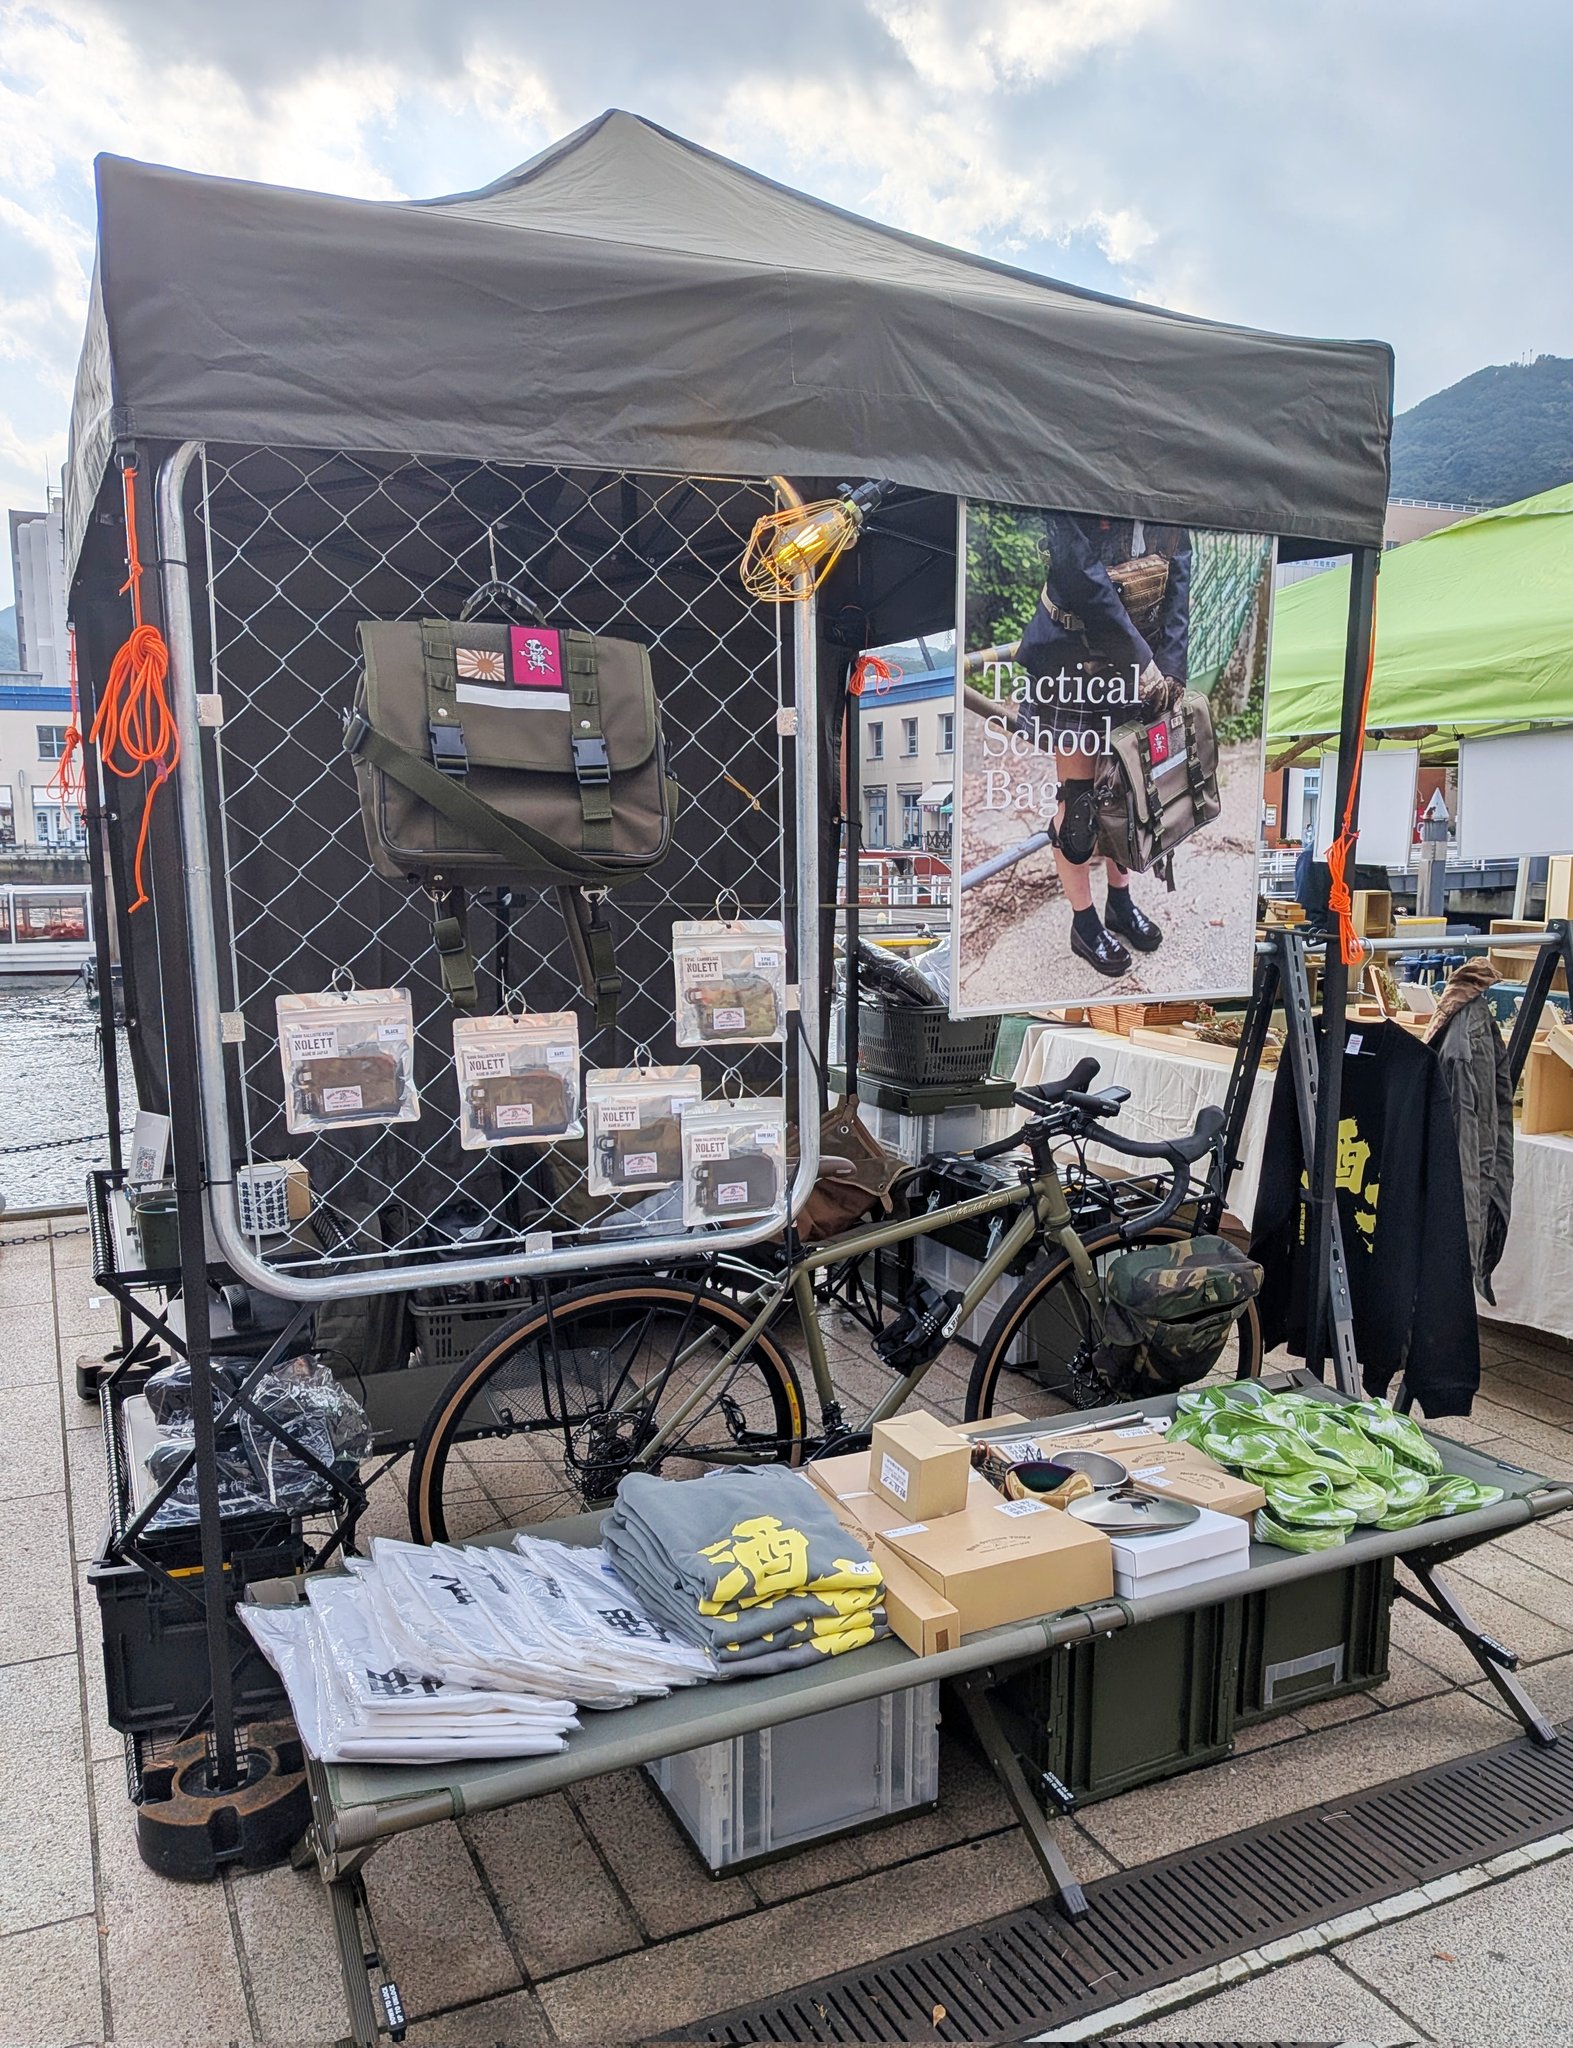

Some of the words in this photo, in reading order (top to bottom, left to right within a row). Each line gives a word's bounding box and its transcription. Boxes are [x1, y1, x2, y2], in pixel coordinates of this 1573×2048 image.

[983, 660, 1142, 704] Tactical
[983, 714, 1114, 757] School
[982, 768, 1062, 818] Bag
[686, 962, 718, 972] NOLETT
[294, 1038, 333, 1051] NOLETT
[469, 1058, 504, 1071] NOLETT
[602, 1111, 635, 1122] NOLETT
[695, 1142, 724, 1153] NOLETT
[955, 1202, 986, 1217] Muddy
[988, 1198, 1004, 1207] Fox
[698, 1516, 809, 1601] 酒
[854, 1565, 869, 1573] M
[395, 2006, 402, 2014] TO
[397, 2015, 404, 2023] UP
